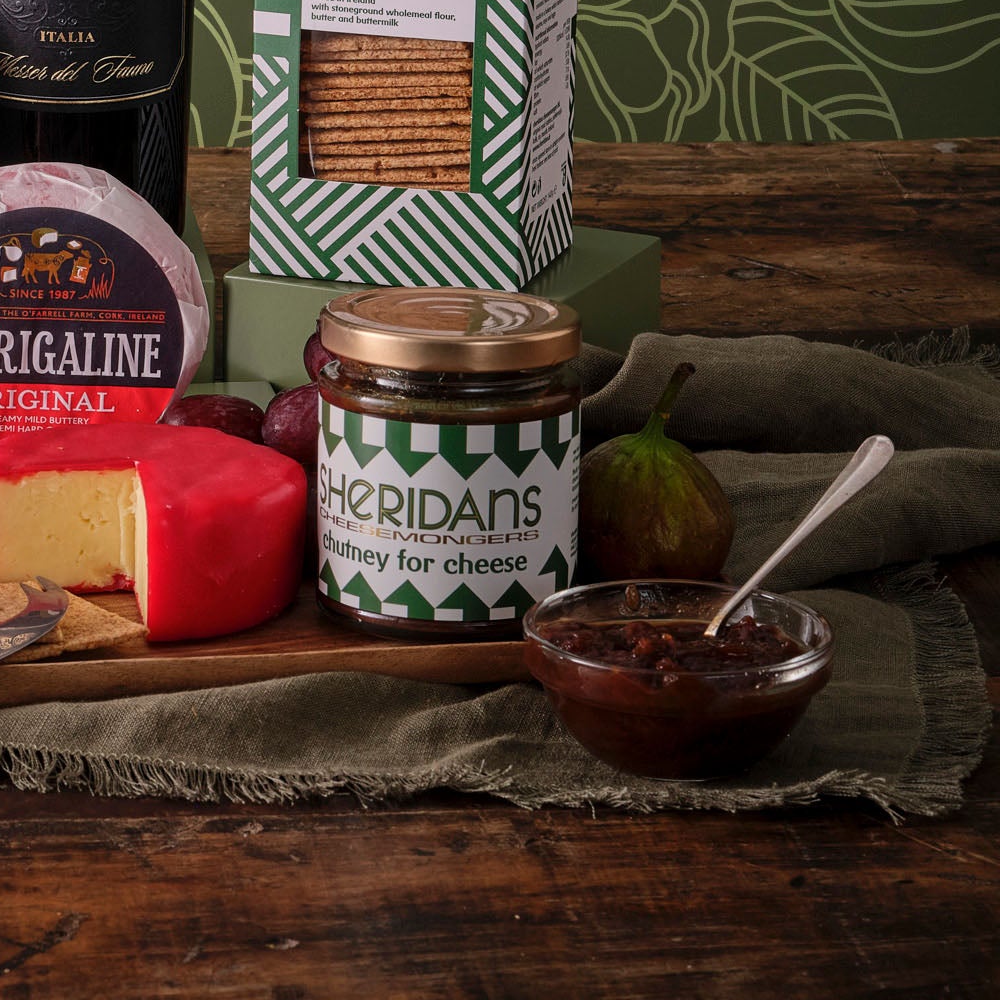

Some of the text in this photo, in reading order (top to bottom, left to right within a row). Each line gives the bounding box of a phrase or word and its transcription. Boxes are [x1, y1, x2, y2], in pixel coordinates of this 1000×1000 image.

[311, 3, 330, 11] with
[331, 5, 384, 16] stoneground
[386, 9, 432, 19] wholemeal
[311, 12, 399, 26] butter and buttermilk
[39, 30, 95, 43] ITALIA
[50, 61, 88, 82] del
[92, 54, 155, 84] Fauno
[9, 289, 76, 300] SINCE 1987
[3, 309, 19, 317] THE
[21, 310, 66, 318] O'FARRELL
[24, 415, 47, 424] MILD
[49, 416, 89, 425] BUTTERY
[319, 506, 540, 545] CHEESEMONGERS
[323, 530, 528, 575] chutney for cheese
